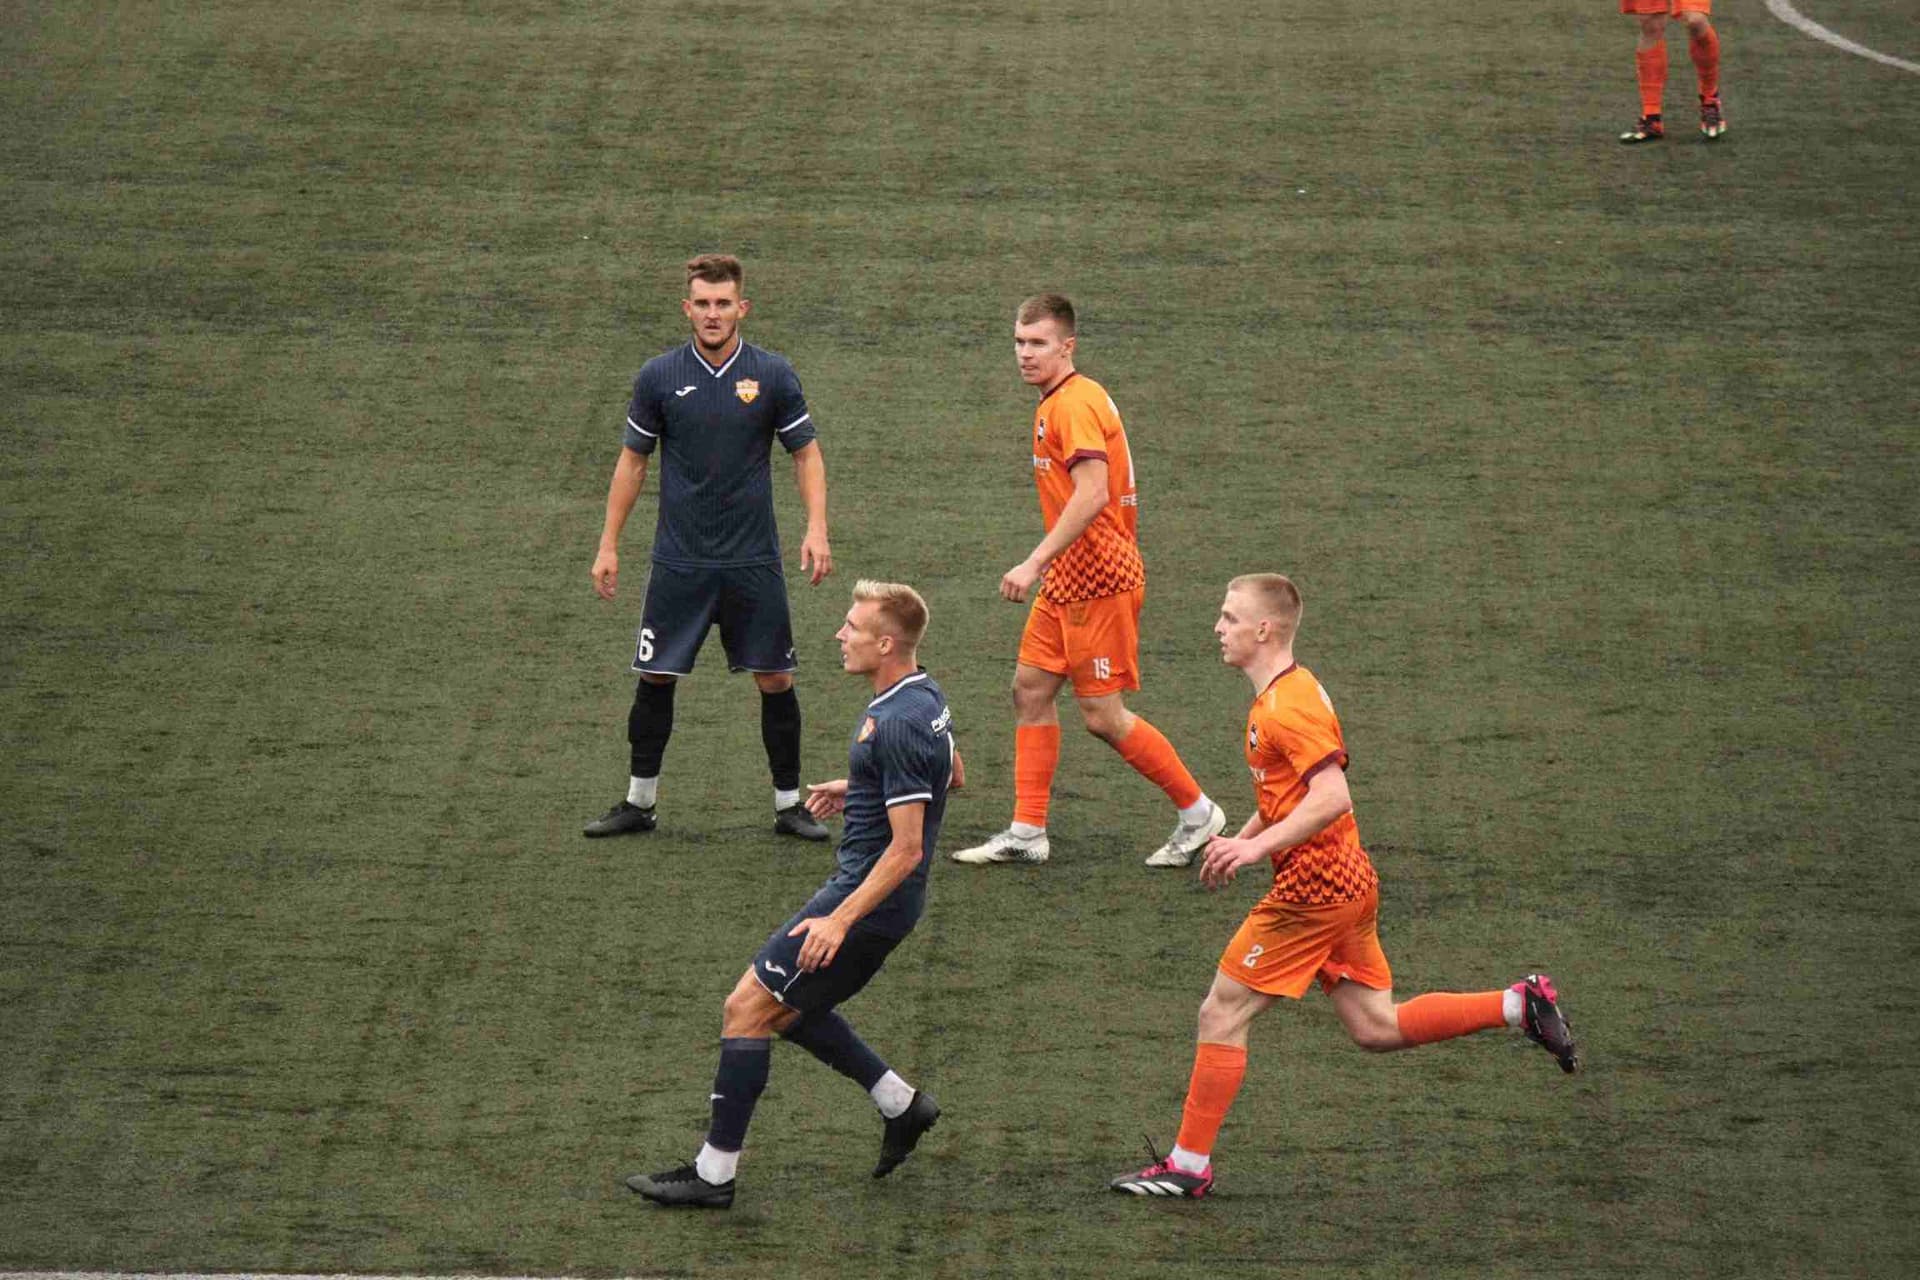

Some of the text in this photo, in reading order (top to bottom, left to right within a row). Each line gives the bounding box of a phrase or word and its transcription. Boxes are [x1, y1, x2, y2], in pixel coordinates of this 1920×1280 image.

[639, 628, 655, 662] 6
[1093, 657, 1110, 680] 15
[1243, 944, 1264, 968] 2
